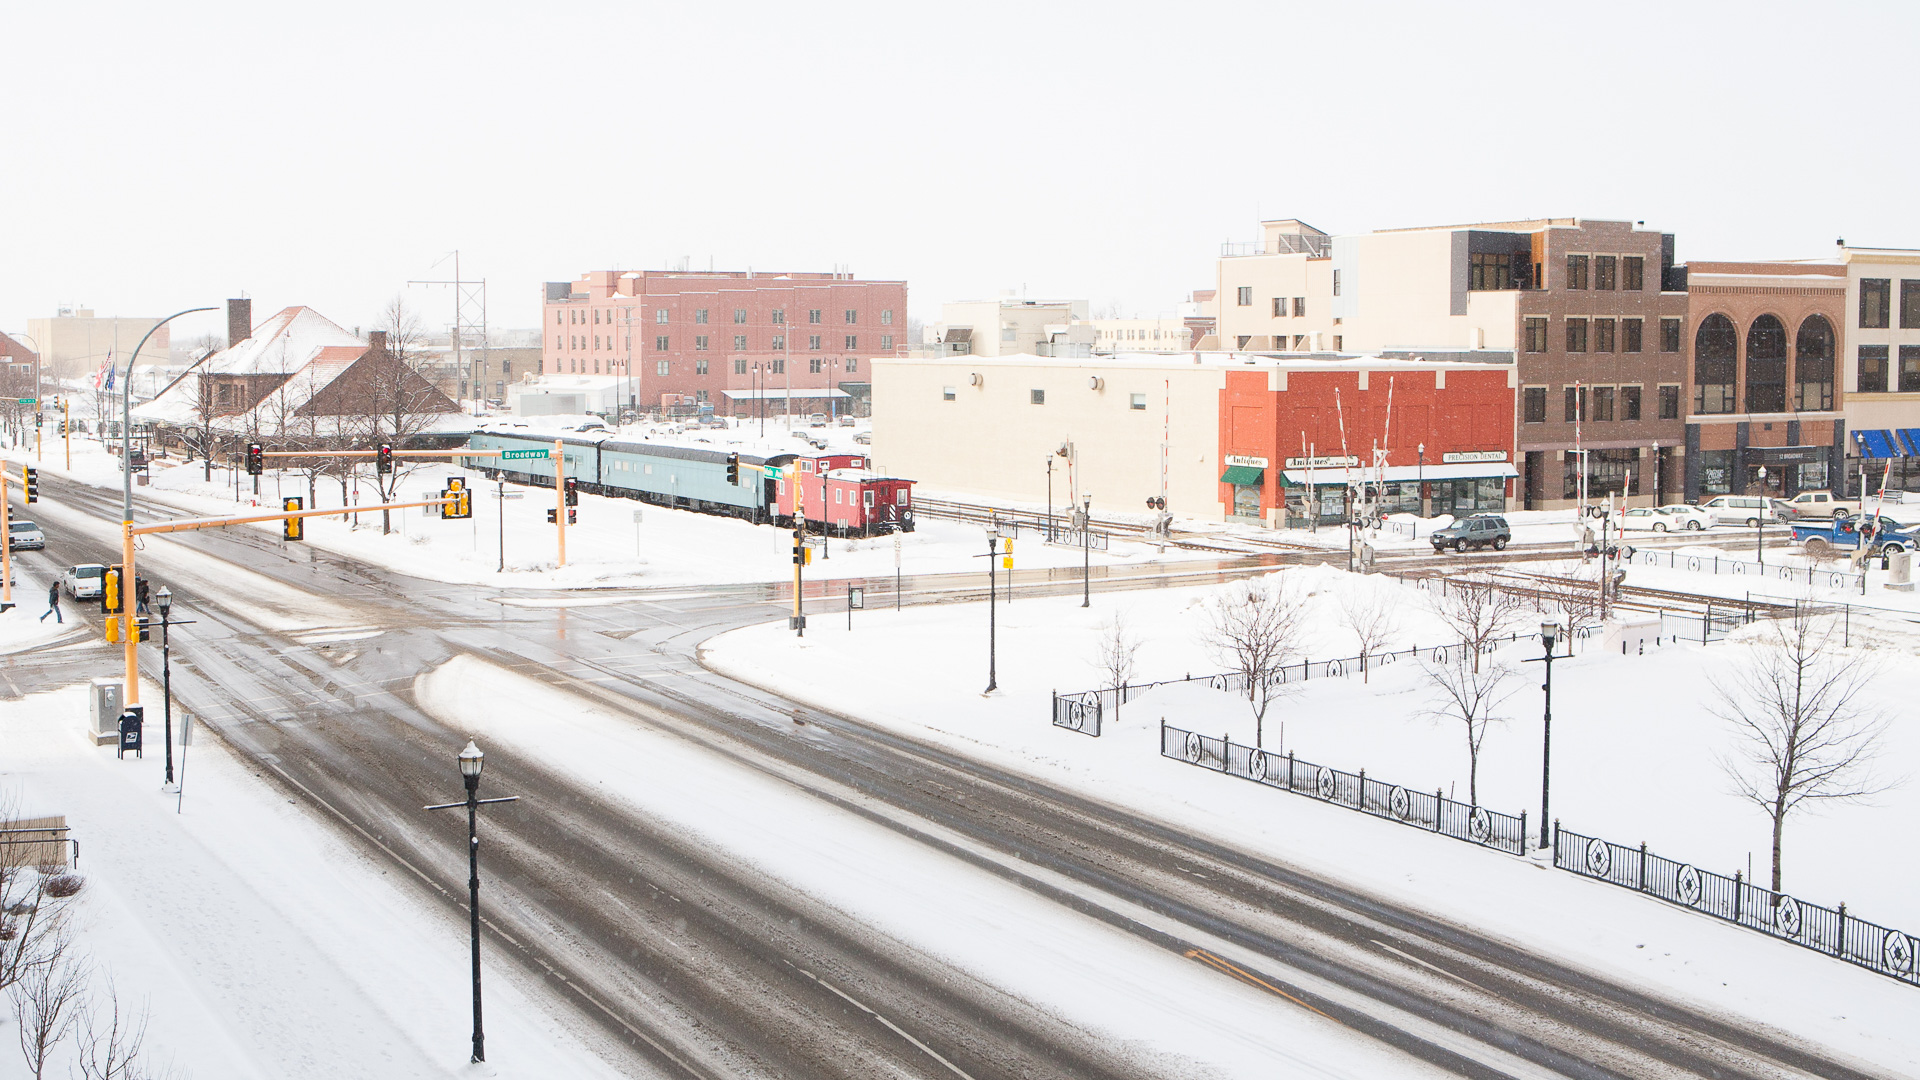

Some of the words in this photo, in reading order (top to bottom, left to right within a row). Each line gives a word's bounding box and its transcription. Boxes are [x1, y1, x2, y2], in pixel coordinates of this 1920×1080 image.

[504, 451, 546, 460] Broadway
[1448, 453, 1478, 461] PRECISION
[1480, 452, 1502, 460] DENTAL
[1231, 455, 1263, 467] Antiques
